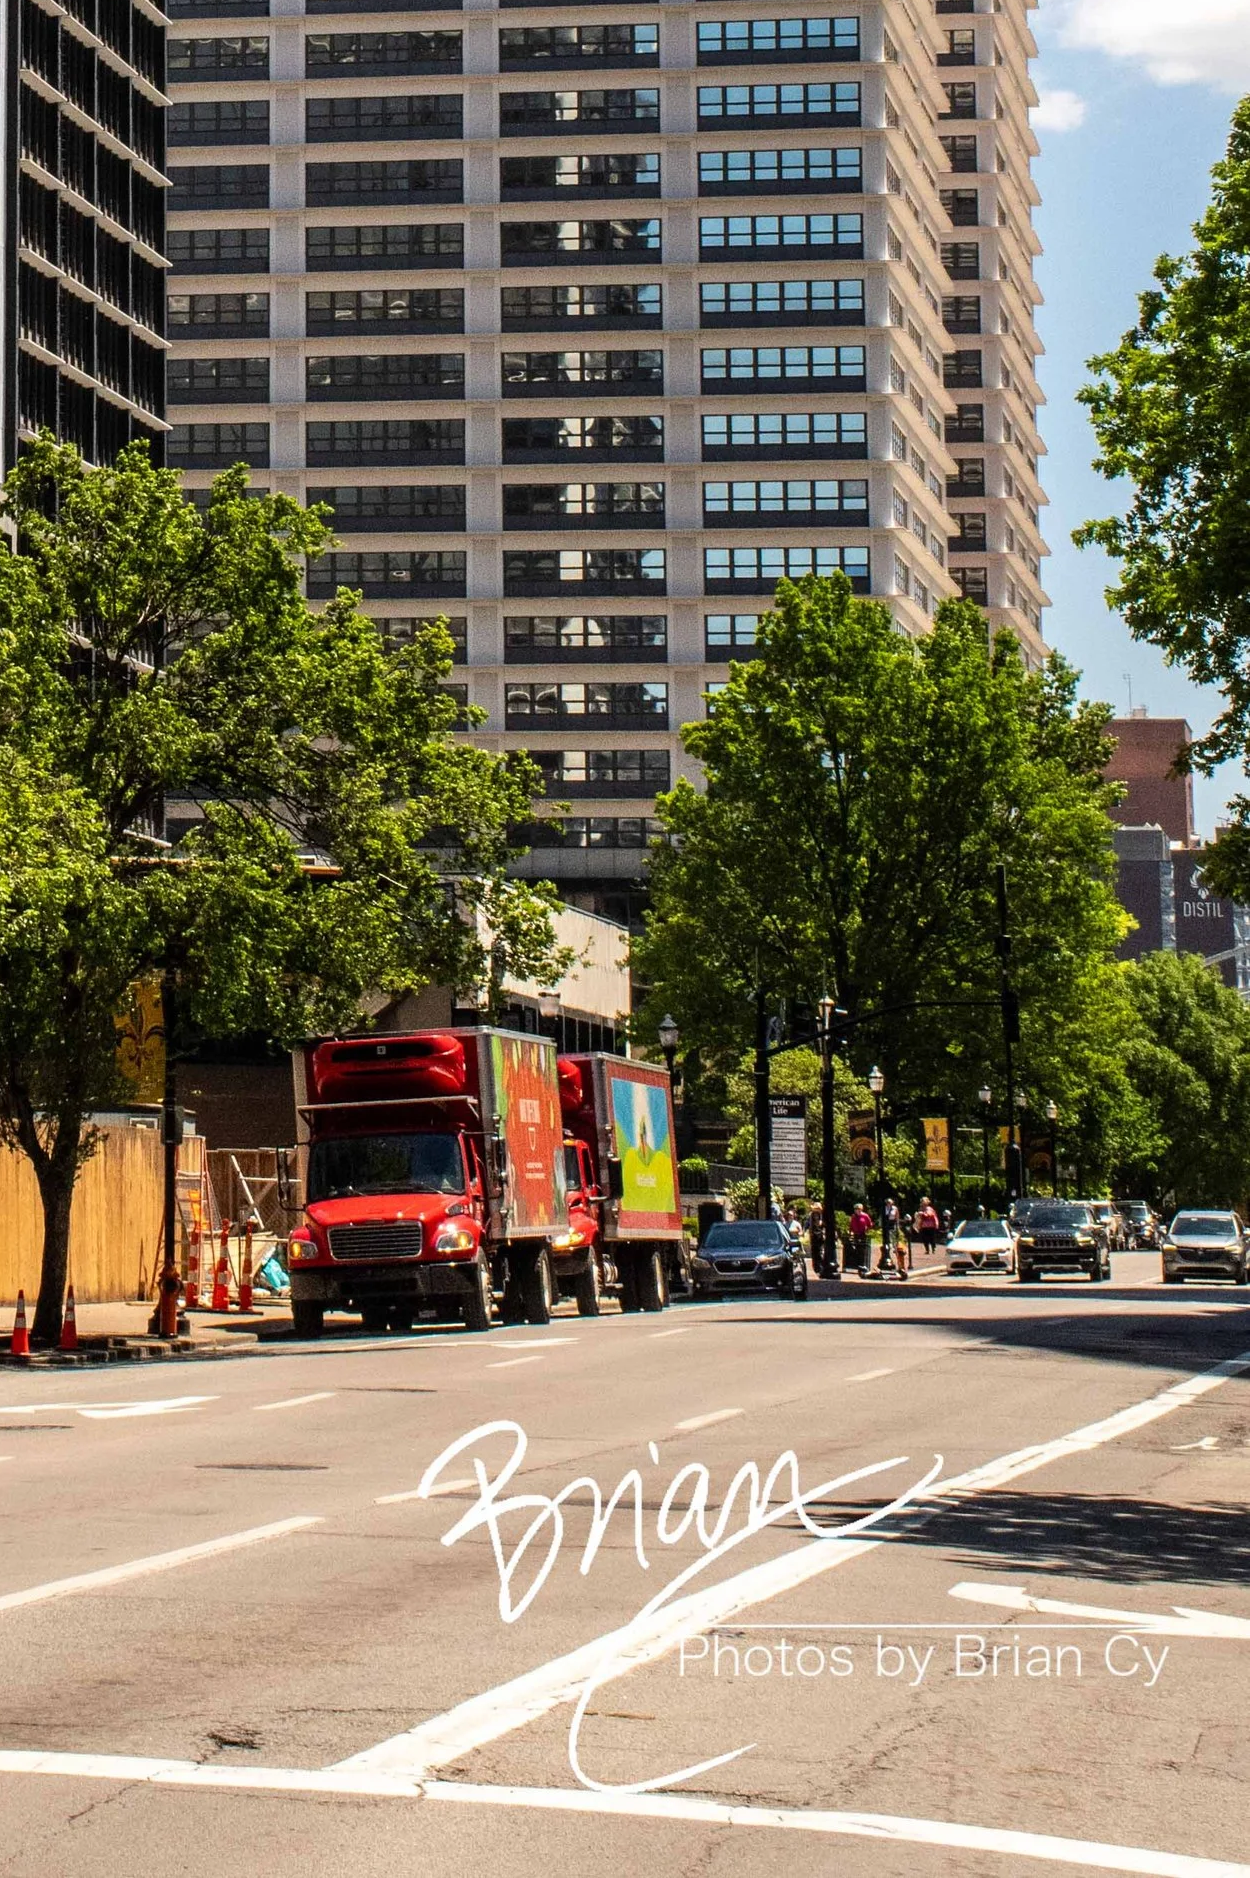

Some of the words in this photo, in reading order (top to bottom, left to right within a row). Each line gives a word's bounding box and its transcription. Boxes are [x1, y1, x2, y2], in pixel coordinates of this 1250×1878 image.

[1183, 901, 1224, 918] DISTIL
[768, 1098, 800, 1107] merican
[773, 1107, 788, 1115] Life
